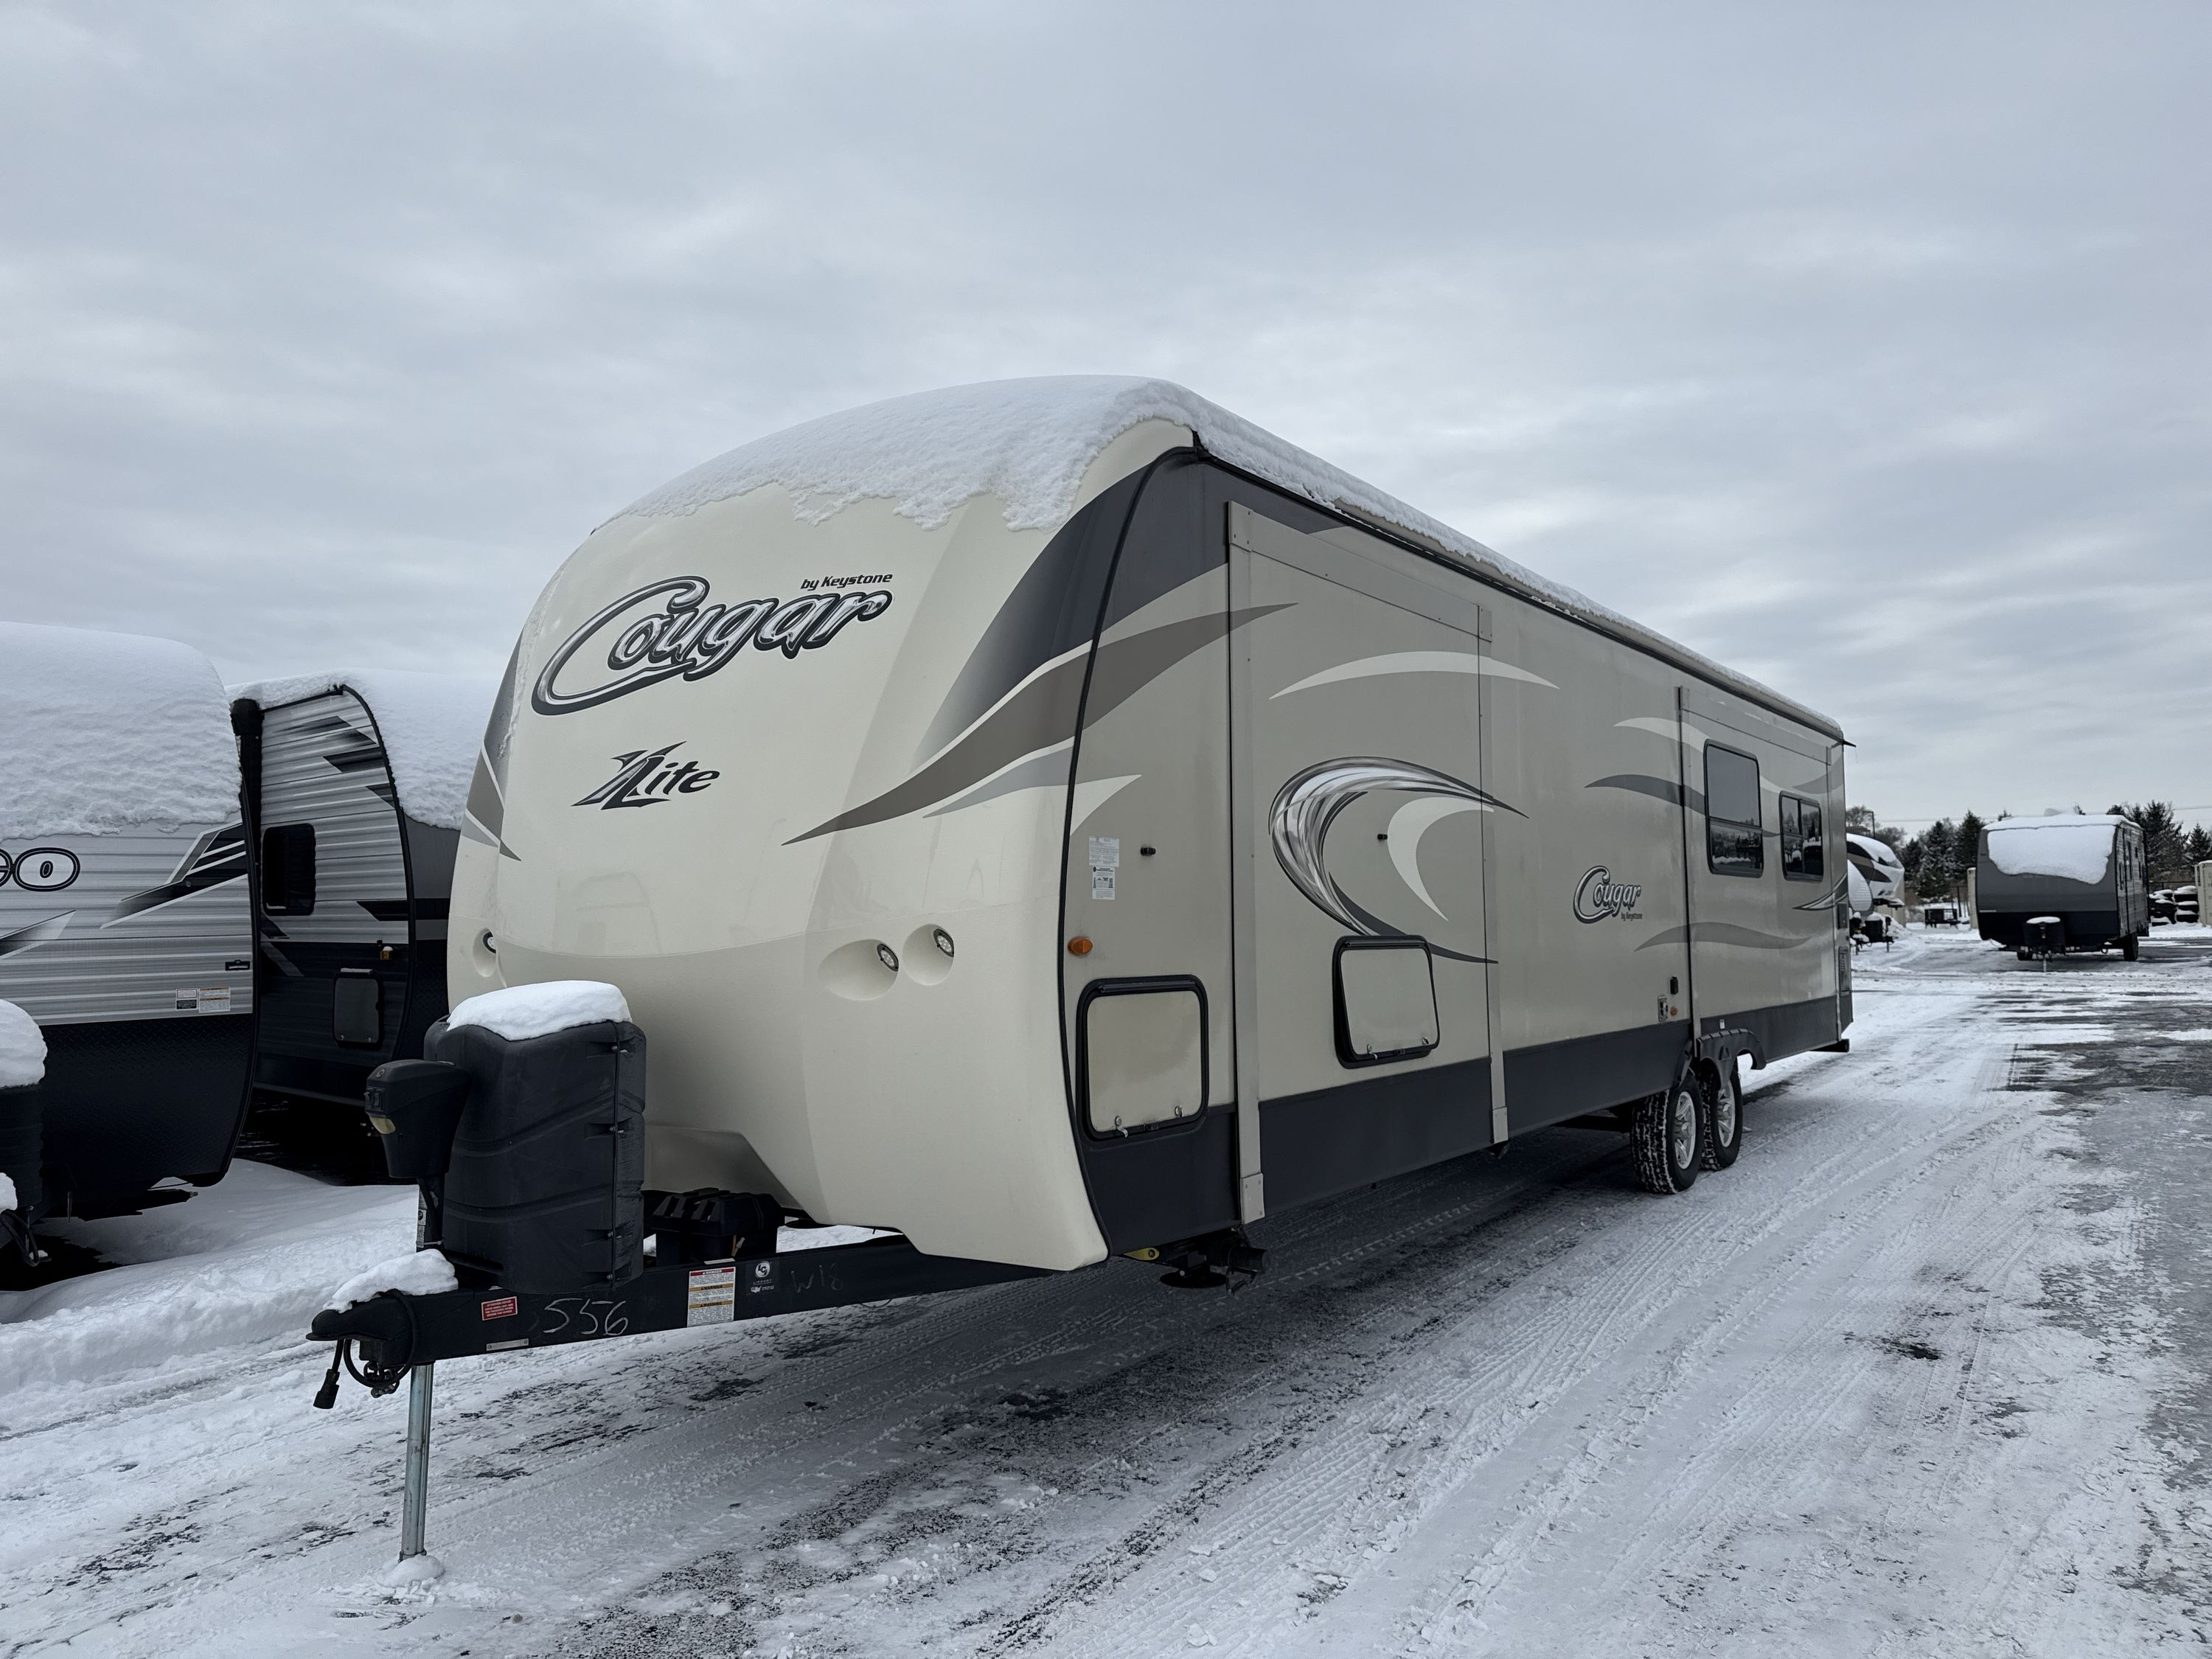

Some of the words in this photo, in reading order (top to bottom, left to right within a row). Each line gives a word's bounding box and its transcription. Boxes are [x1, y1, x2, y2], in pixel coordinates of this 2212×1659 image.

[800, 579, 819, 591] by
[821, 574, 893, 588] Keystone
[531, 575, 893, 716] Cougar
[1573, 865, 1642, 924] Cougar
[543, 1297, 629, 1336] 556
